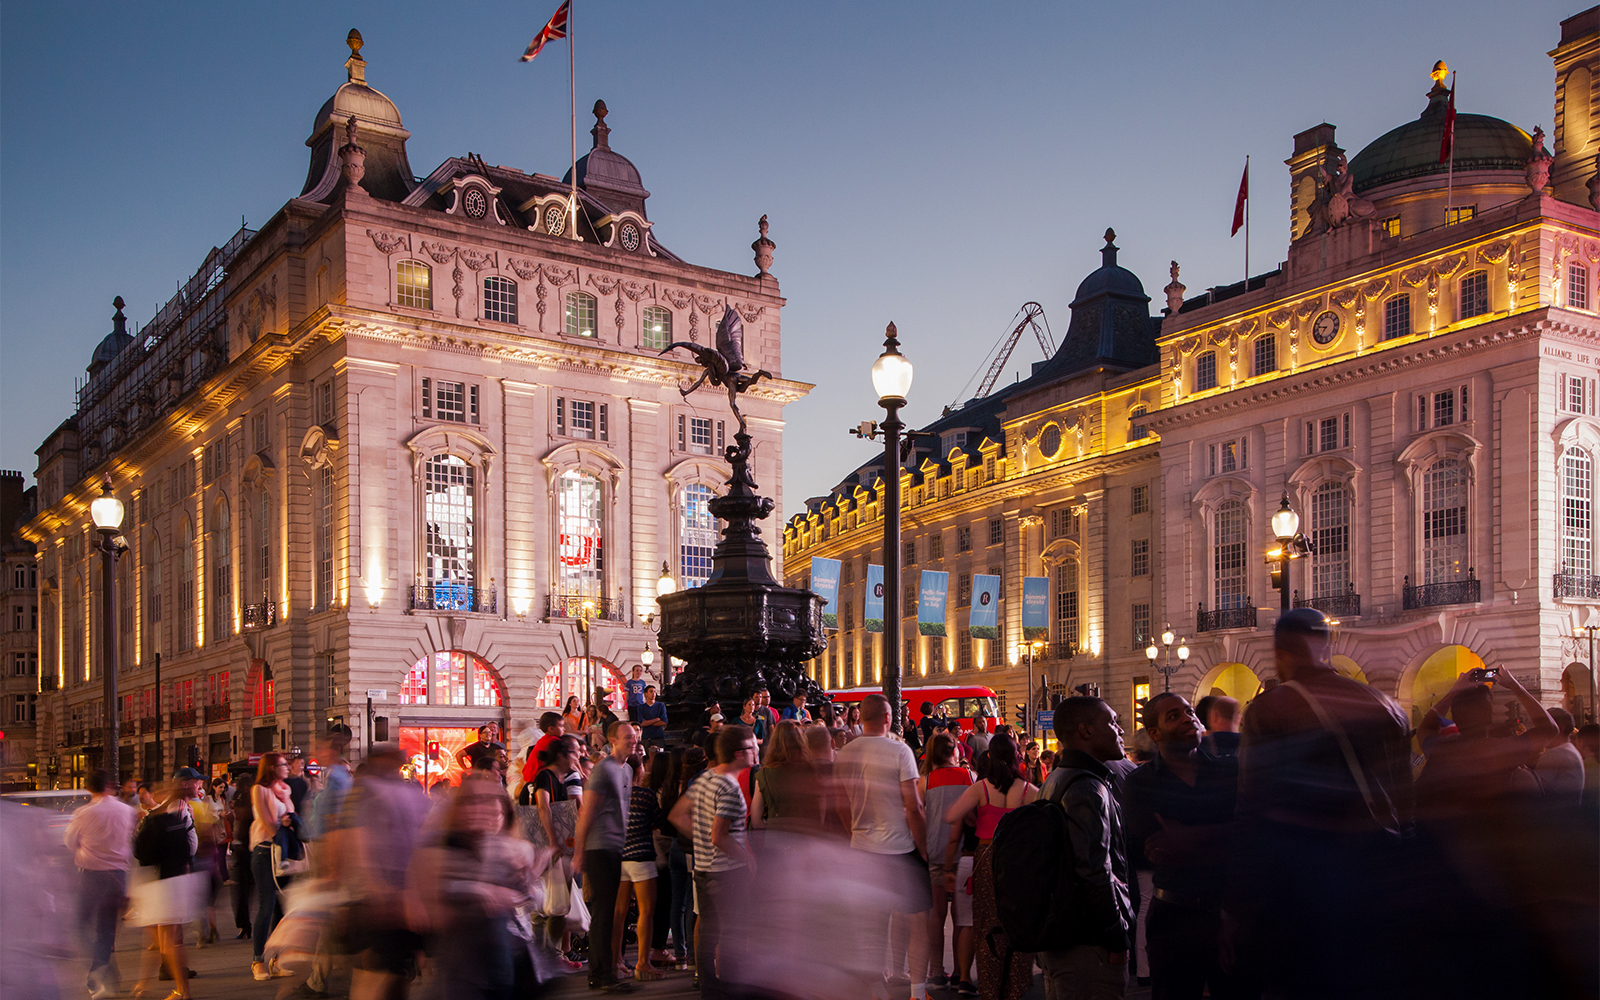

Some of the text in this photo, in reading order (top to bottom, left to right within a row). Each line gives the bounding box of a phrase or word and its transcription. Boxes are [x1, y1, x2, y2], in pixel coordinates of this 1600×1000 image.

[1544, 346, 1572, 360] ALLIANCE
[1577, 353, 1590, 364] LIFE
[876, 585, 883, 596] R
[982, 593, 989, 604] R
[633, 686, 643, 694] 82
